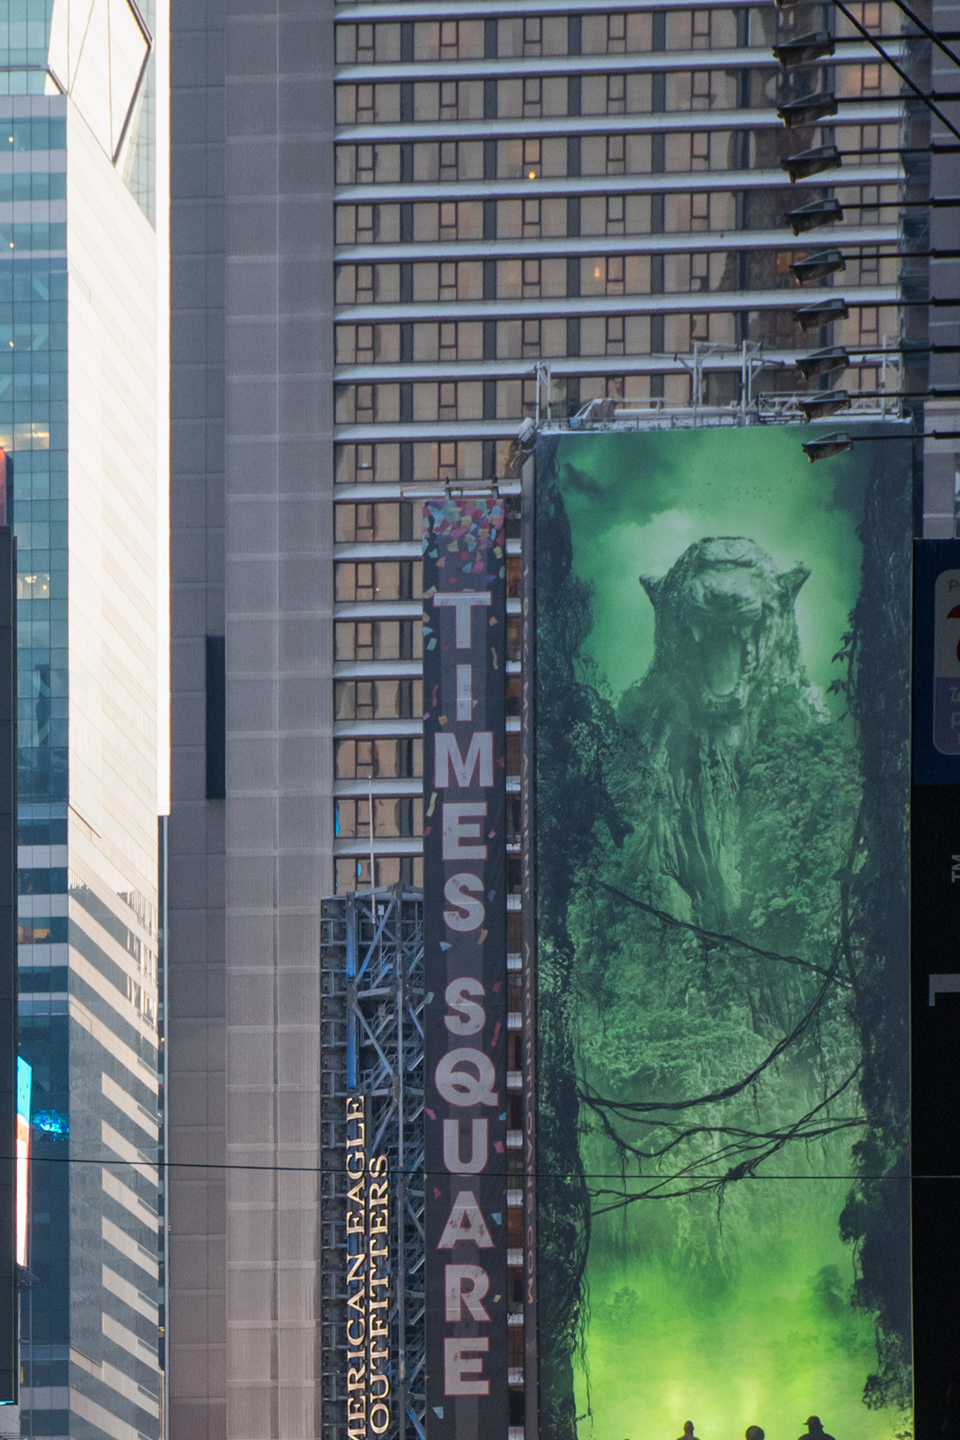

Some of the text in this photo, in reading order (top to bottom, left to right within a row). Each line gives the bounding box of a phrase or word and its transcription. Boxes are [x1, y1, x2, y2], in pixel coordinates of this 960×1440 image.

[432, 590, 499, 1397] TIMES SQUARE
[346, 1095, 366, 1237] EAGLE
[368, 1154, 391, 1435] OUTFITTERS
